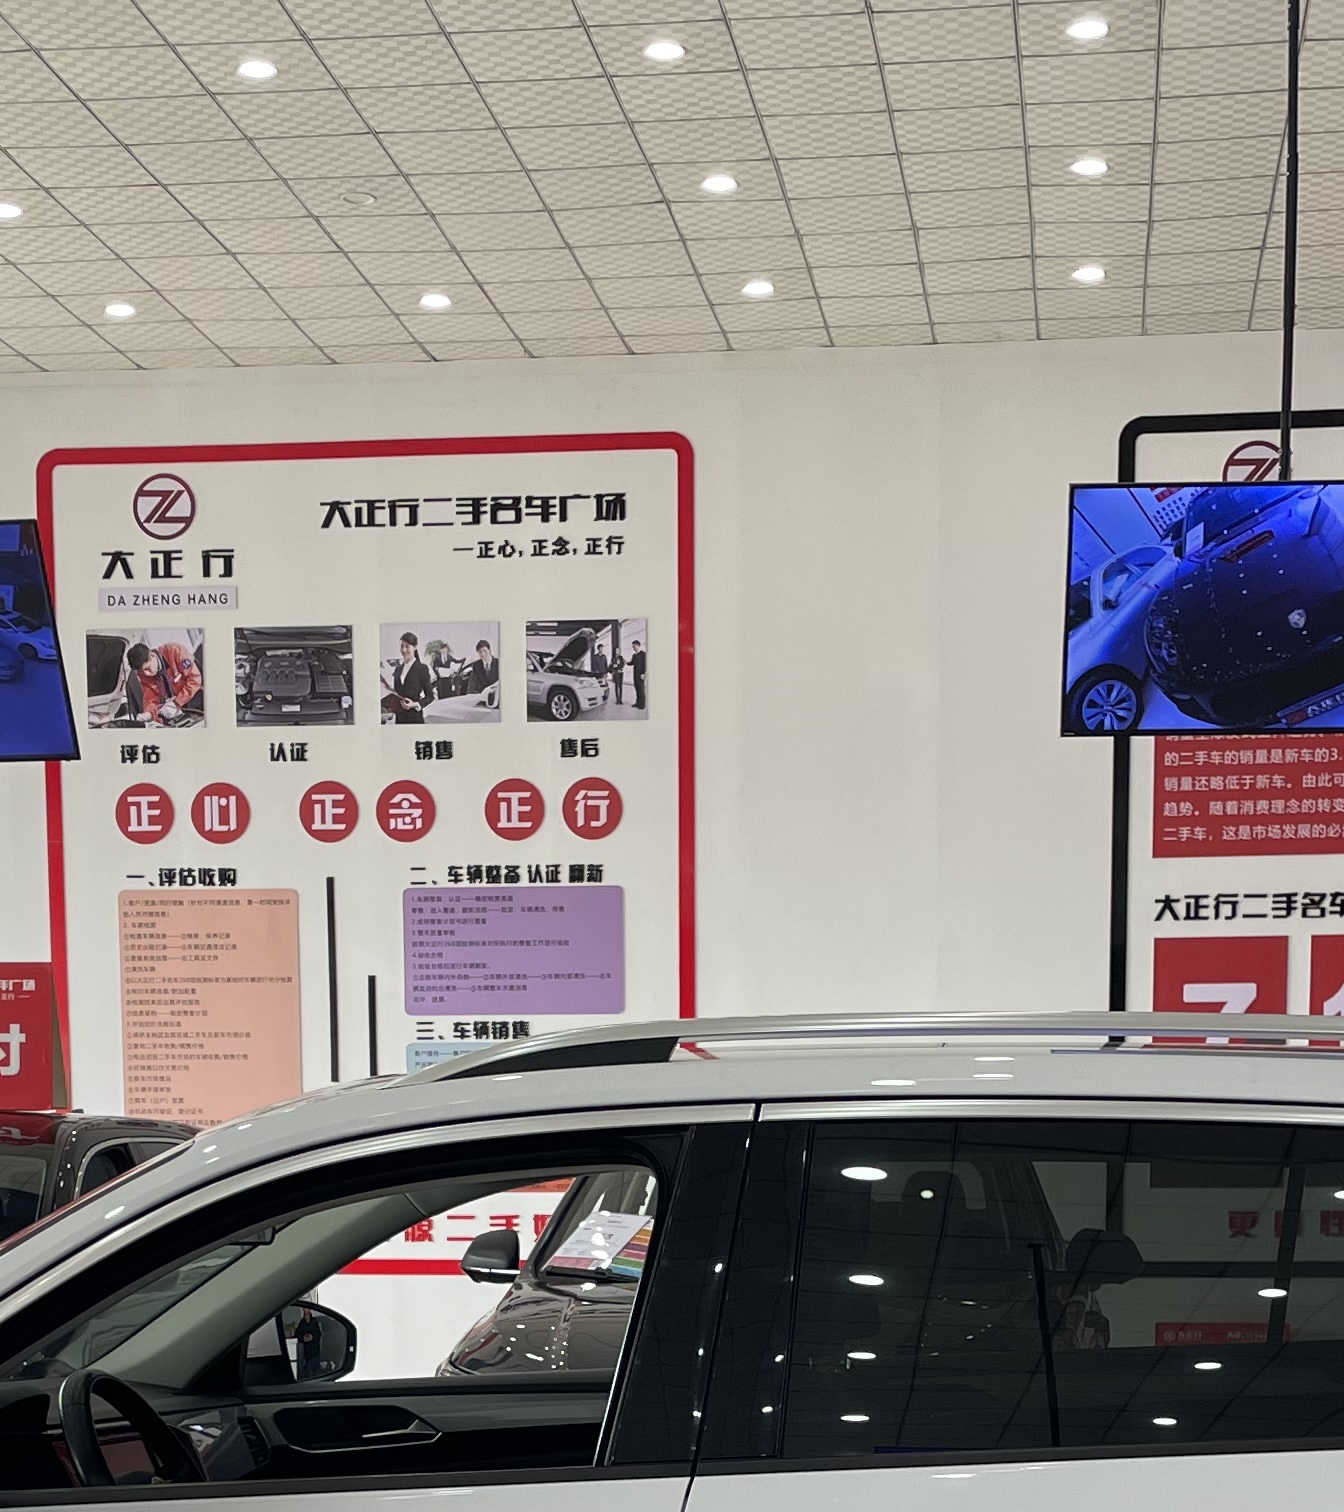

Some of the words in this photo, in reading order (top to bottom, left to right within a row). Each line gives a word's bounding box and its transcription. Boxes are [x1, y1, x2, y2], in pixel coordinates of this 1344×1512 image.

[320, 492, 627, 530] 大正行二手名车广场
[101, 548, 234, 580] 大正行
[108, 593, 126, 607] DA
[133, 593, 181, 606] ZHENG
[187, 592, 229, 605] HANG
[120, 744, 160, 765] 评估
[269, 742, 309, 763] 认证
[415, 740, 454, 761] 销售
[560, 738, 600, 759] 售后
[126, 868, 238, 887] 一、评估收购
[527, 864, 561, 883] 认证
